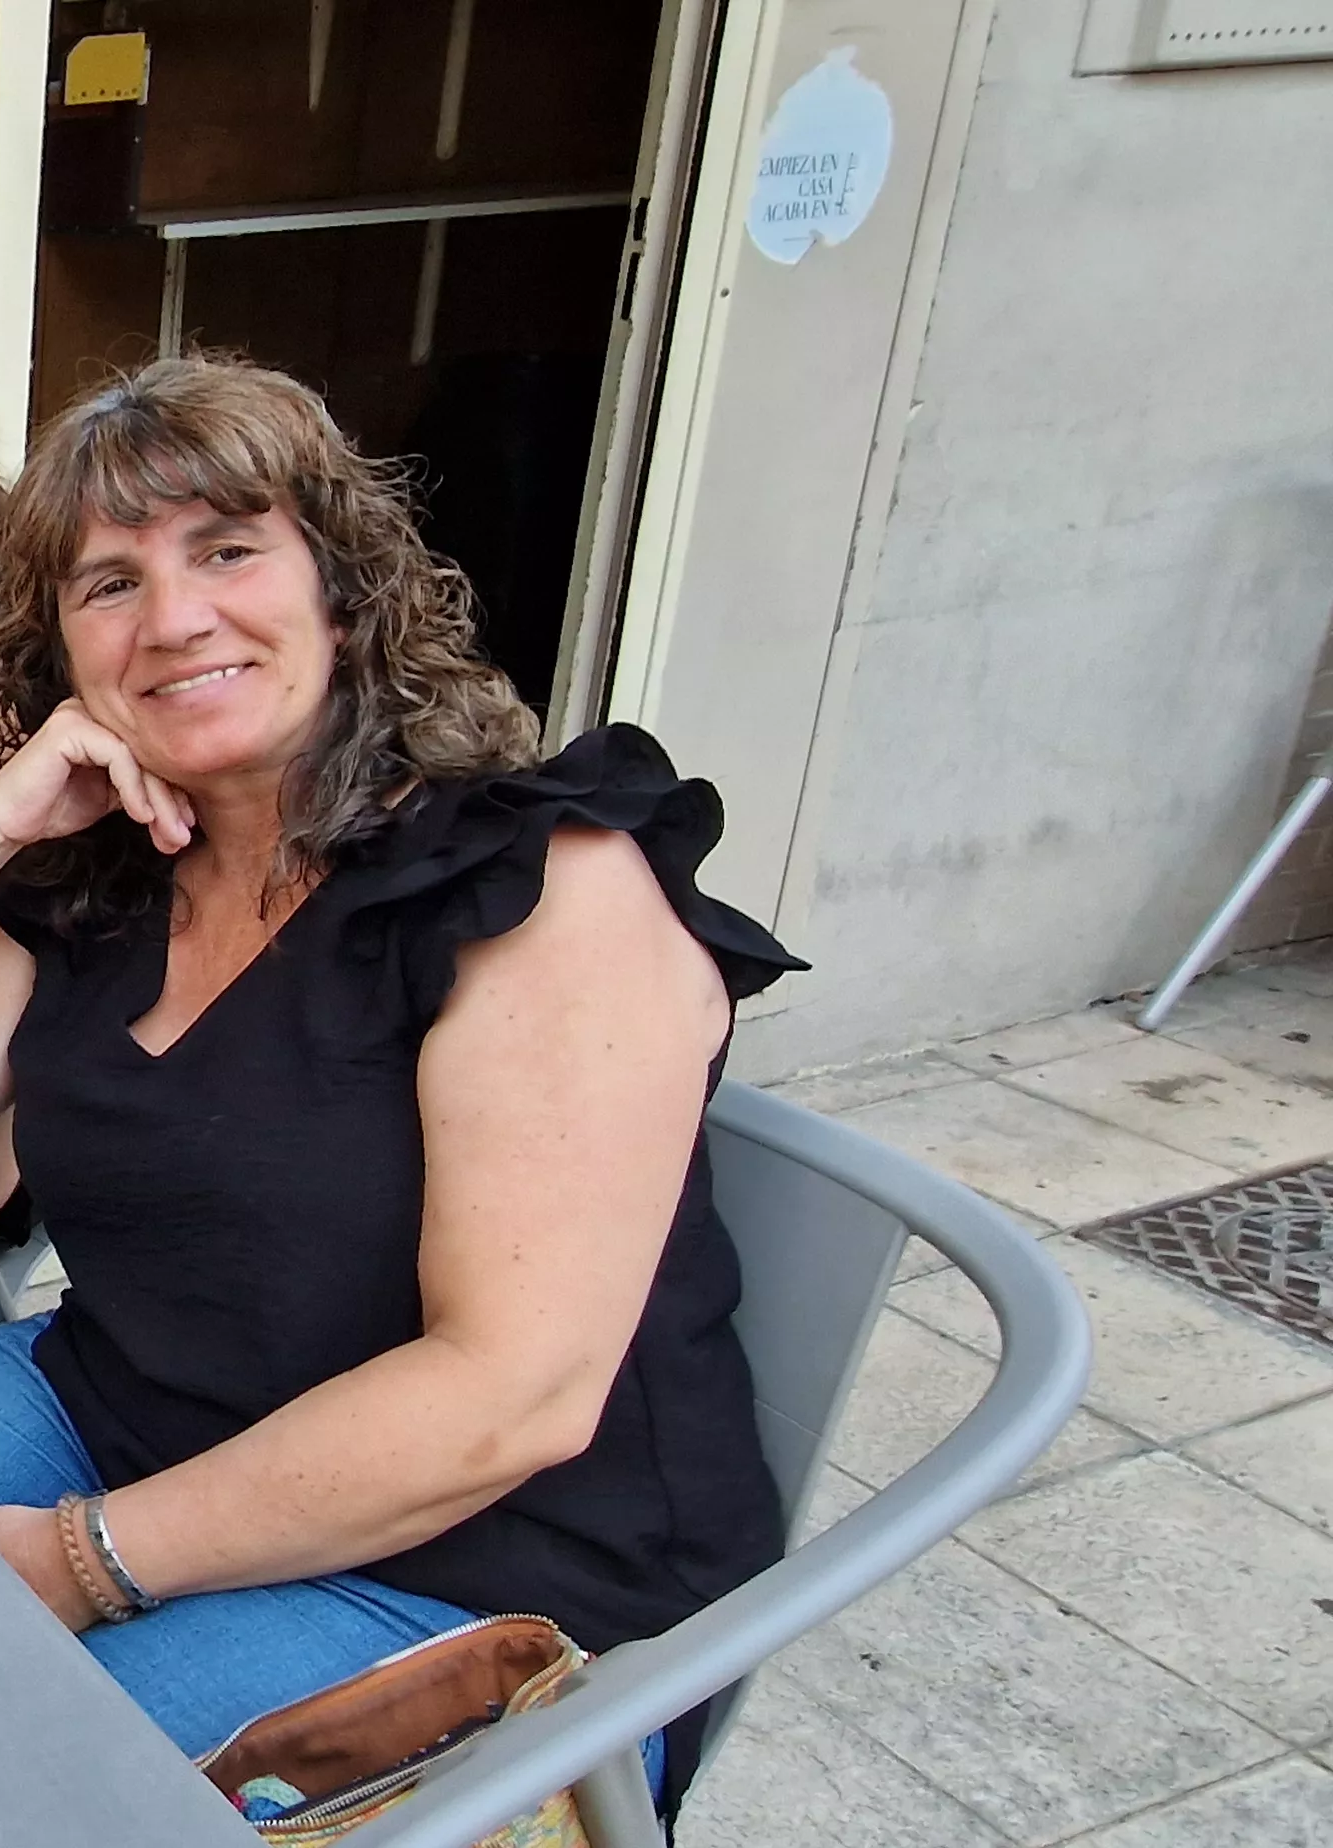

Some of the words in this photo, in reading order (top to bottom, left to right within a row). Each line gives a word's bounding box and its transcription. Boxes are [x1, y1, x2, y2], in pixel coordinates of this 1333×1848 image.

[759, 155, 817, 176] EMPIEZA
[820, 153, 837, 173] EN
[798, 176, 833, 197] CASA
[762, 201, 808, 222] ACABA
[810, 199, 829, 218] EN
